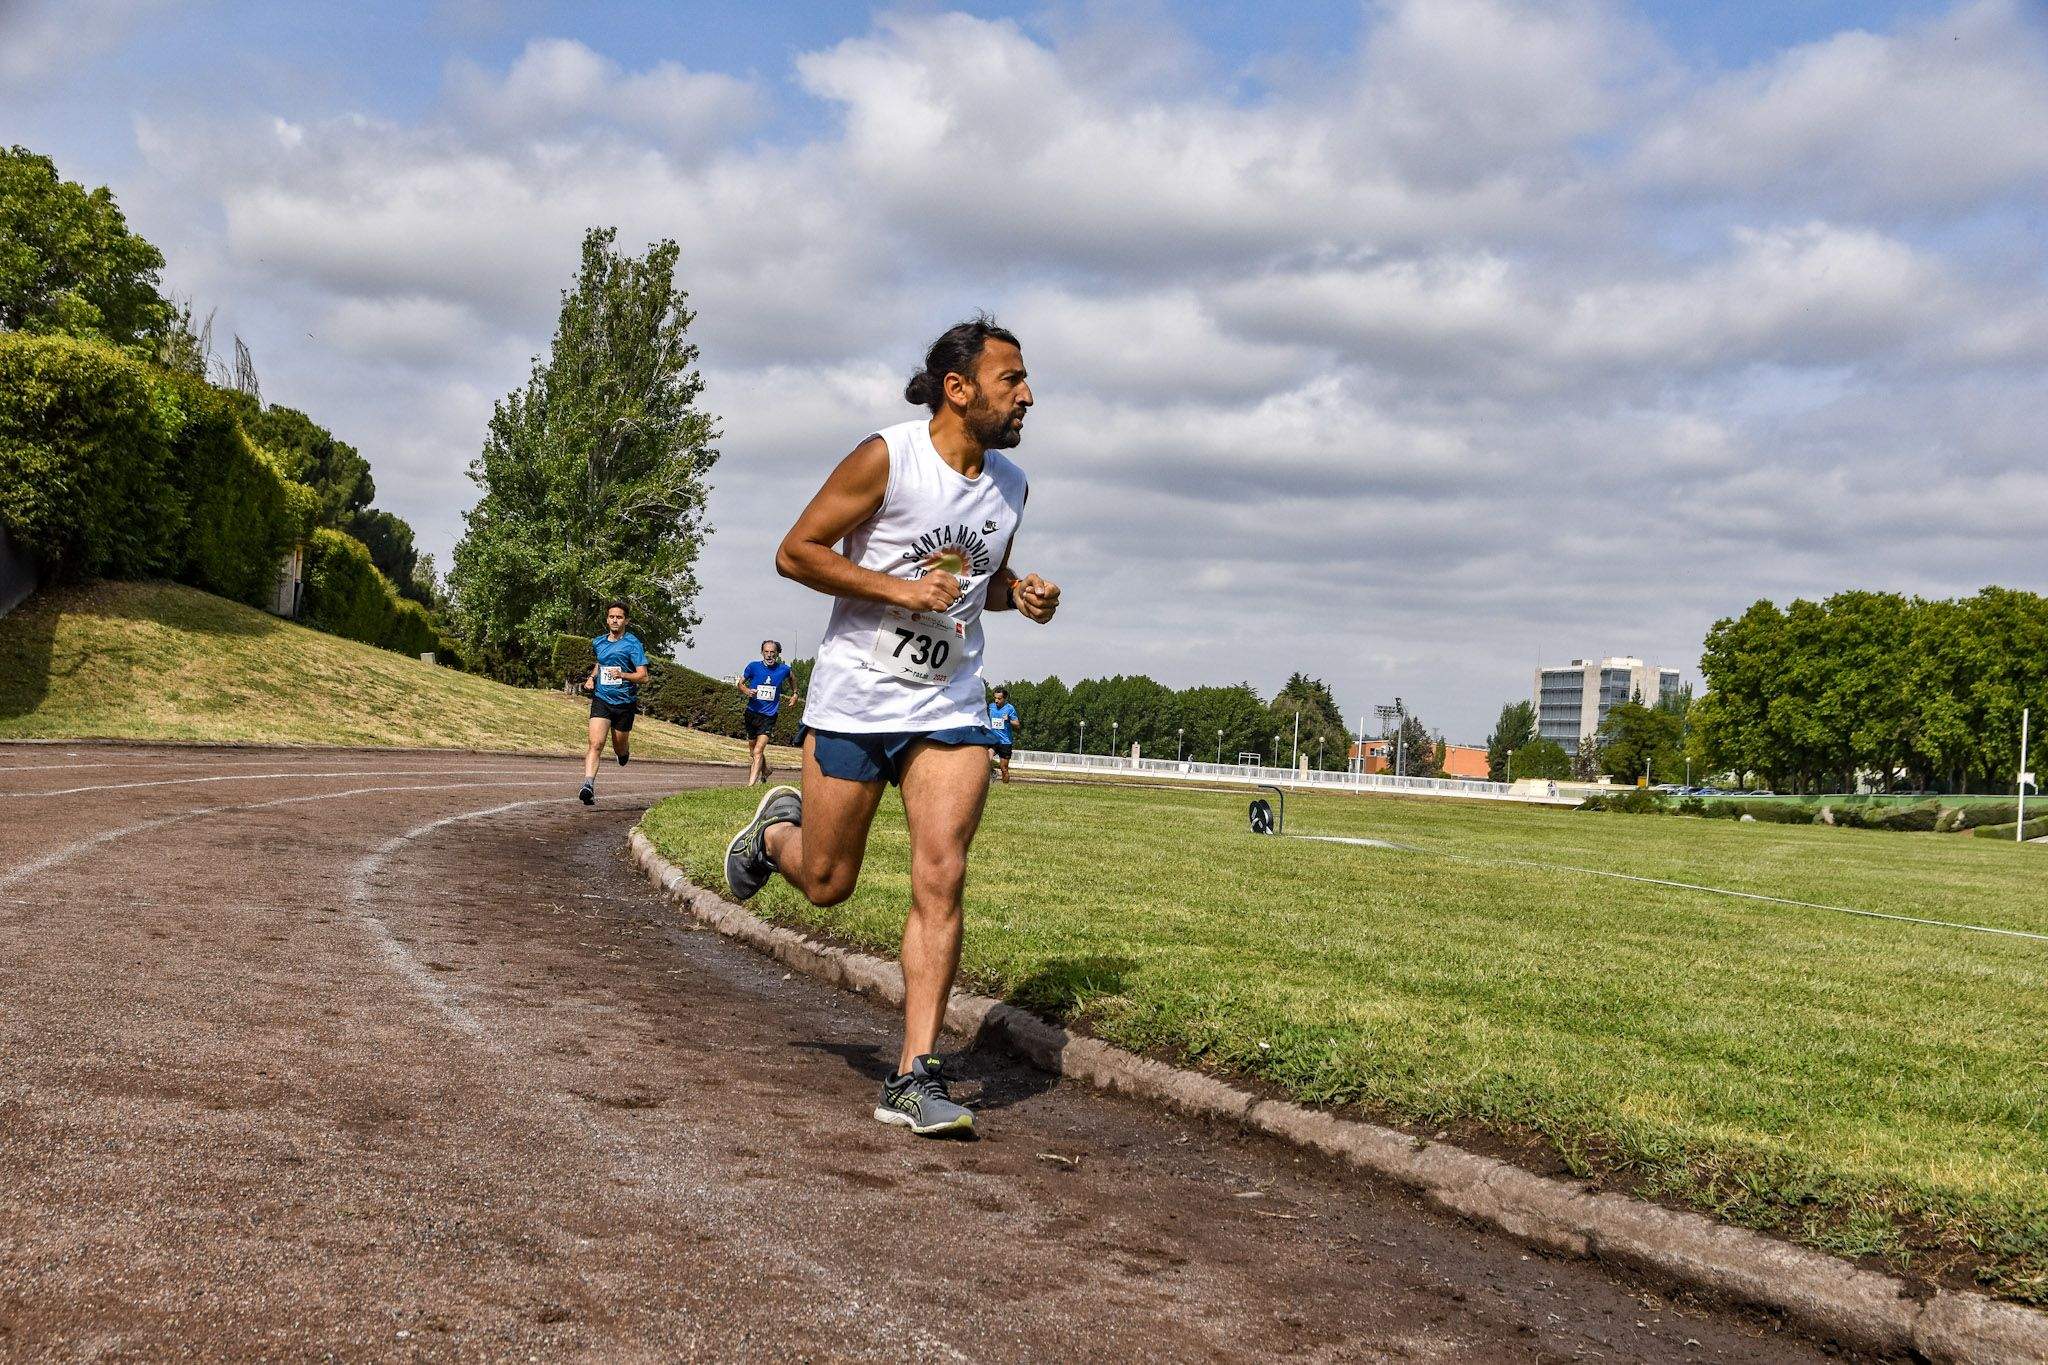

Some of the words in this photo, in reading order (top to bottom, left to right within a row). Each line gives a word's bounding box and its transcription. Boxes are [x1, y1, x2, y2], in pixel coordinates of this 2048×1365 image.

[903, 525, 952, 563] SANTA
[955, 525, 990, 577] MONICA
[892, 627, 949, 669] 730
